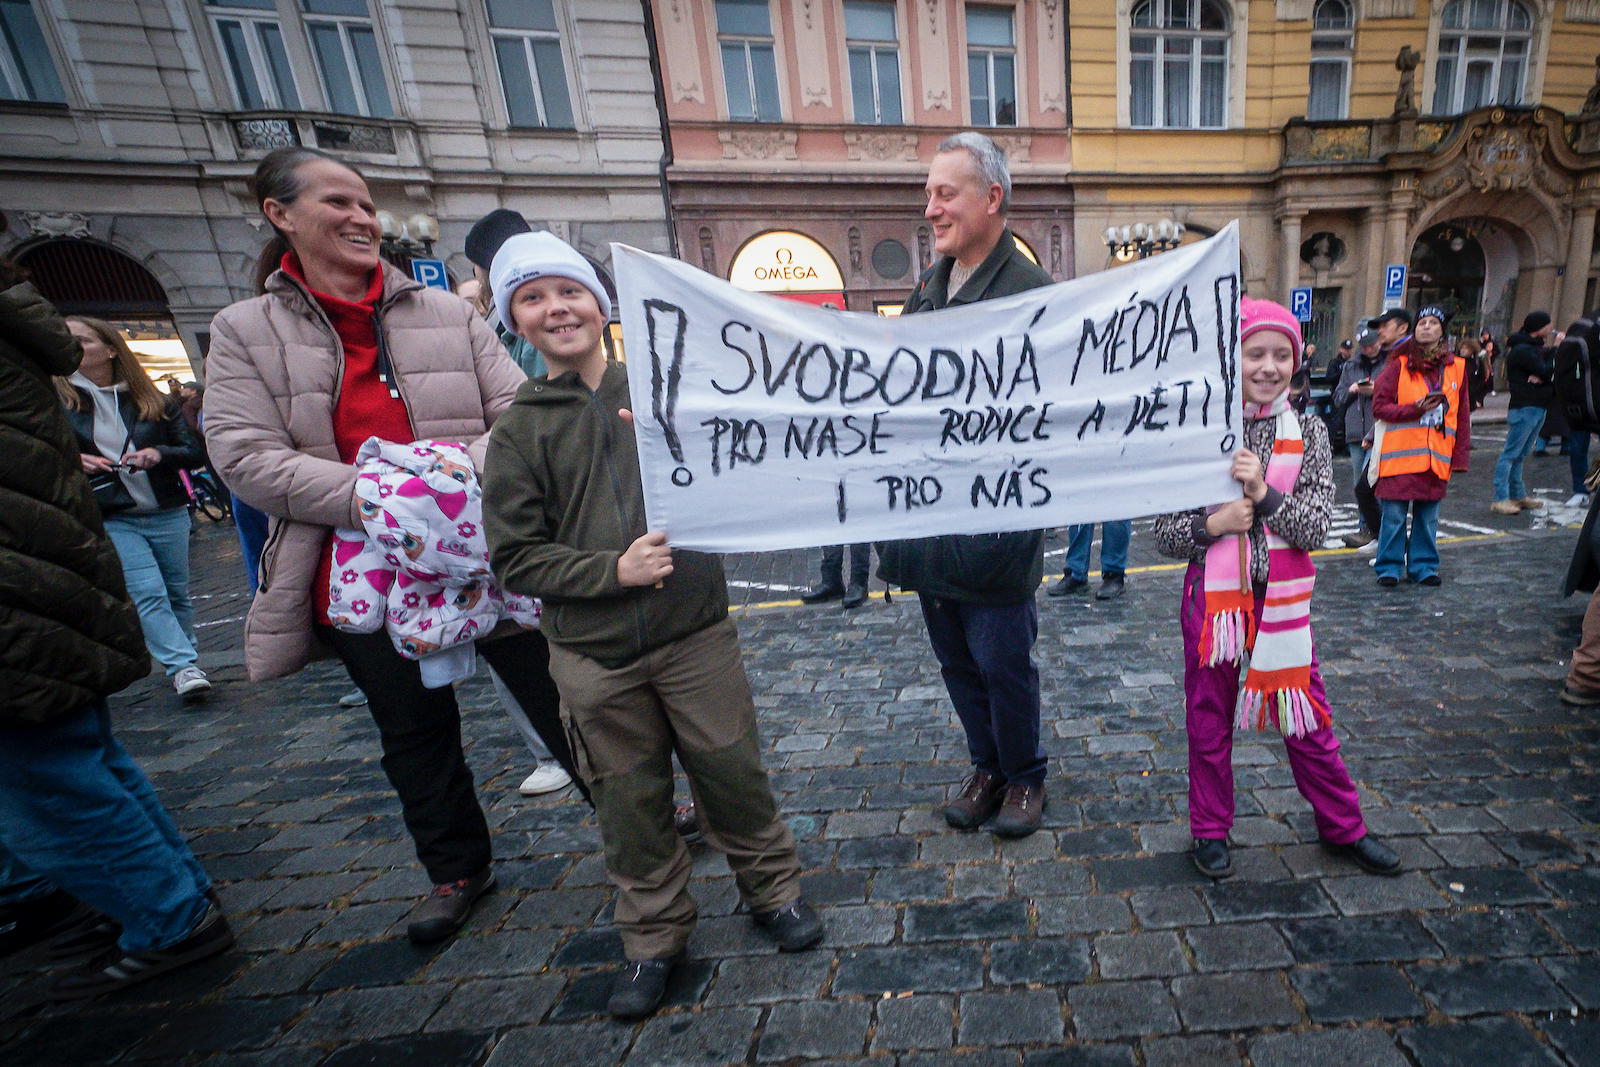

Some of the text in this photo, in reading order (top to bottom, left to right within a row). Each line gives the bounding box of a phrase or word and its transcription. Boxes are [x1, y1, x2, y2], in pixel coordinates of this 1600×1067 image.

[419, 264, 439, 287] P
[754, 266, 818, 281] OMEGA
[1390, 269, 1402, 288] P
[1294, 292, 1307, 312] P
[711, 305, 1047, 407] SVOBODNÁ
[1070, 284, 1198, 387] MÉDIA
[701, 417, 767, 476] PRO
[1077, 398, 1106, 440] A
[874, 475, 942, 512] PRO
[971, 456, 1051, 508] NÁS
